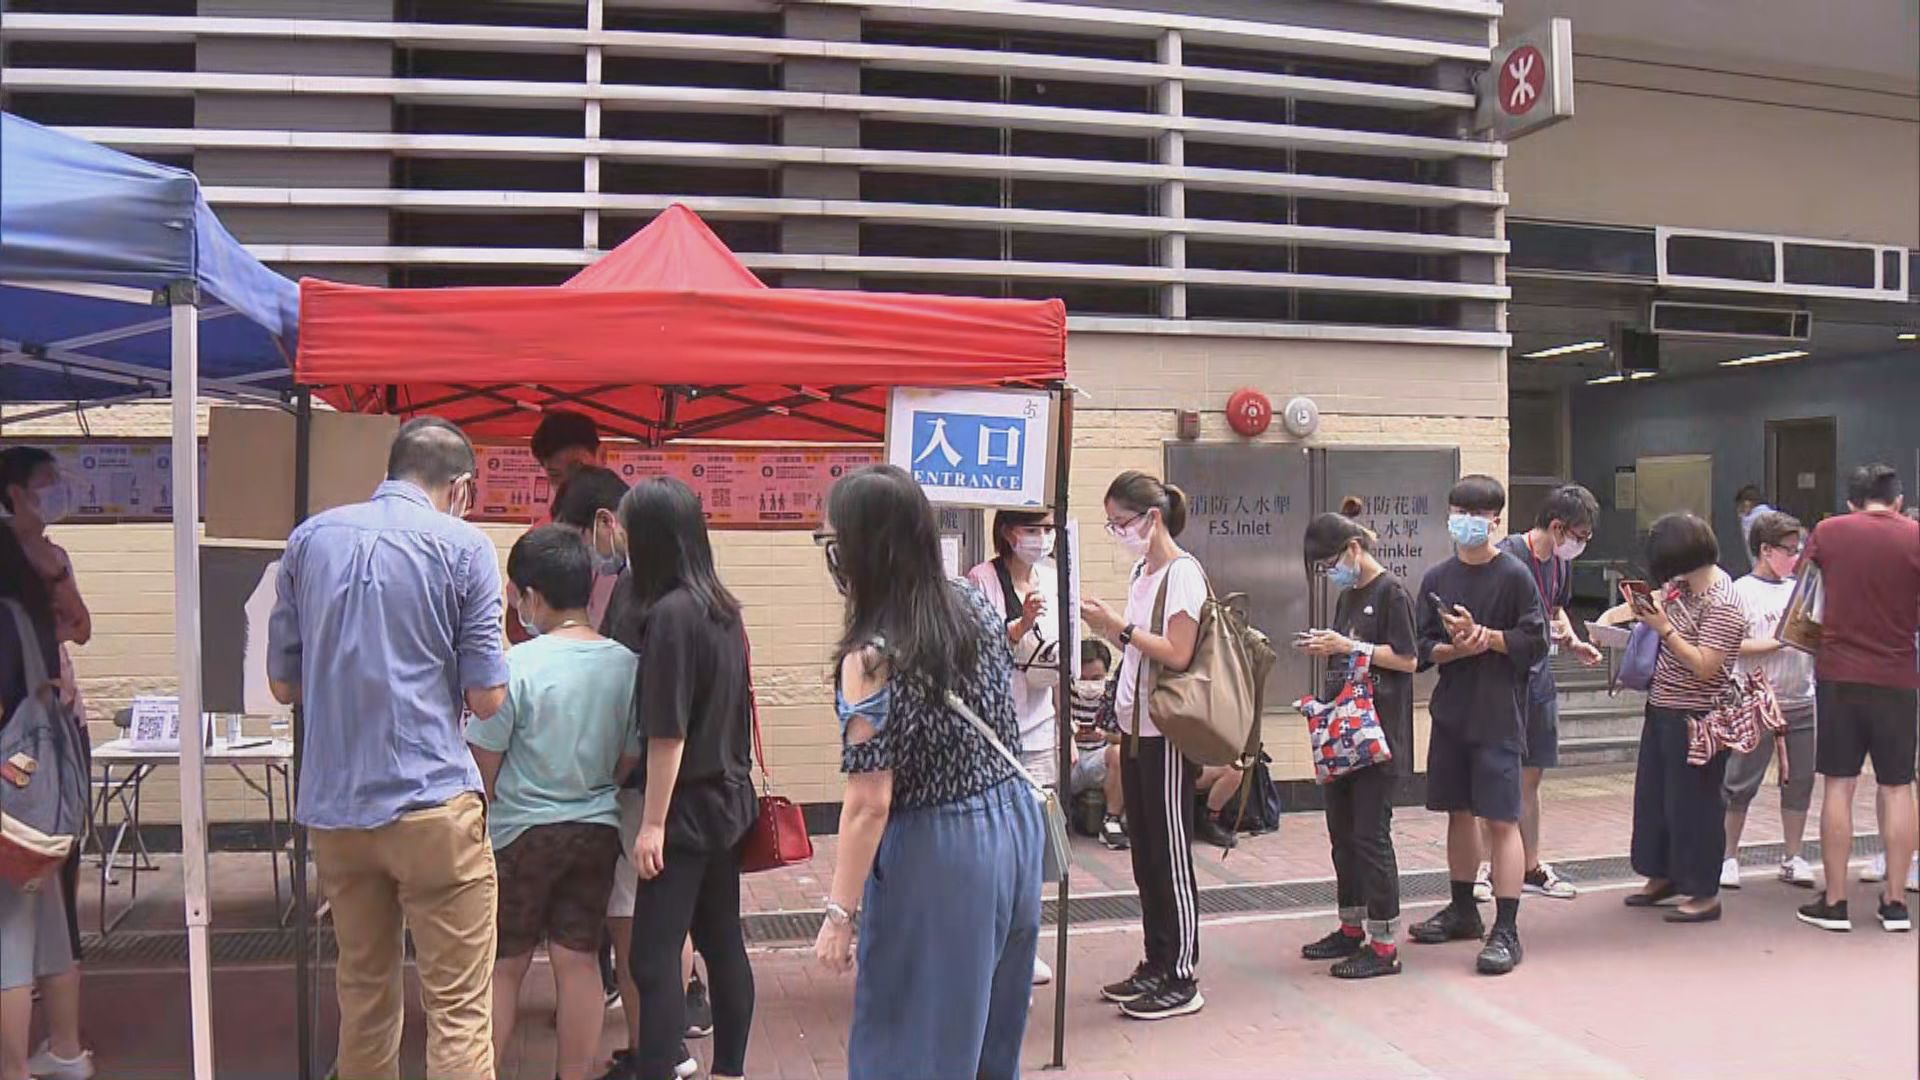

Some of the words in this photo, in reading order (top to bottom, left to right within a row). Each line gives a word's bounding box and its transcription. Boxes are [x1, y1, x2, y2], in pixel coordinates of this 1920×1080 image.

[914, 418, 1021, 467] 入口
[914, 470, 1021, 490] ENTRANCE
[1237, 520, 1271, 535] Inlet
[1371, 544, 1423, 559] prinkler
